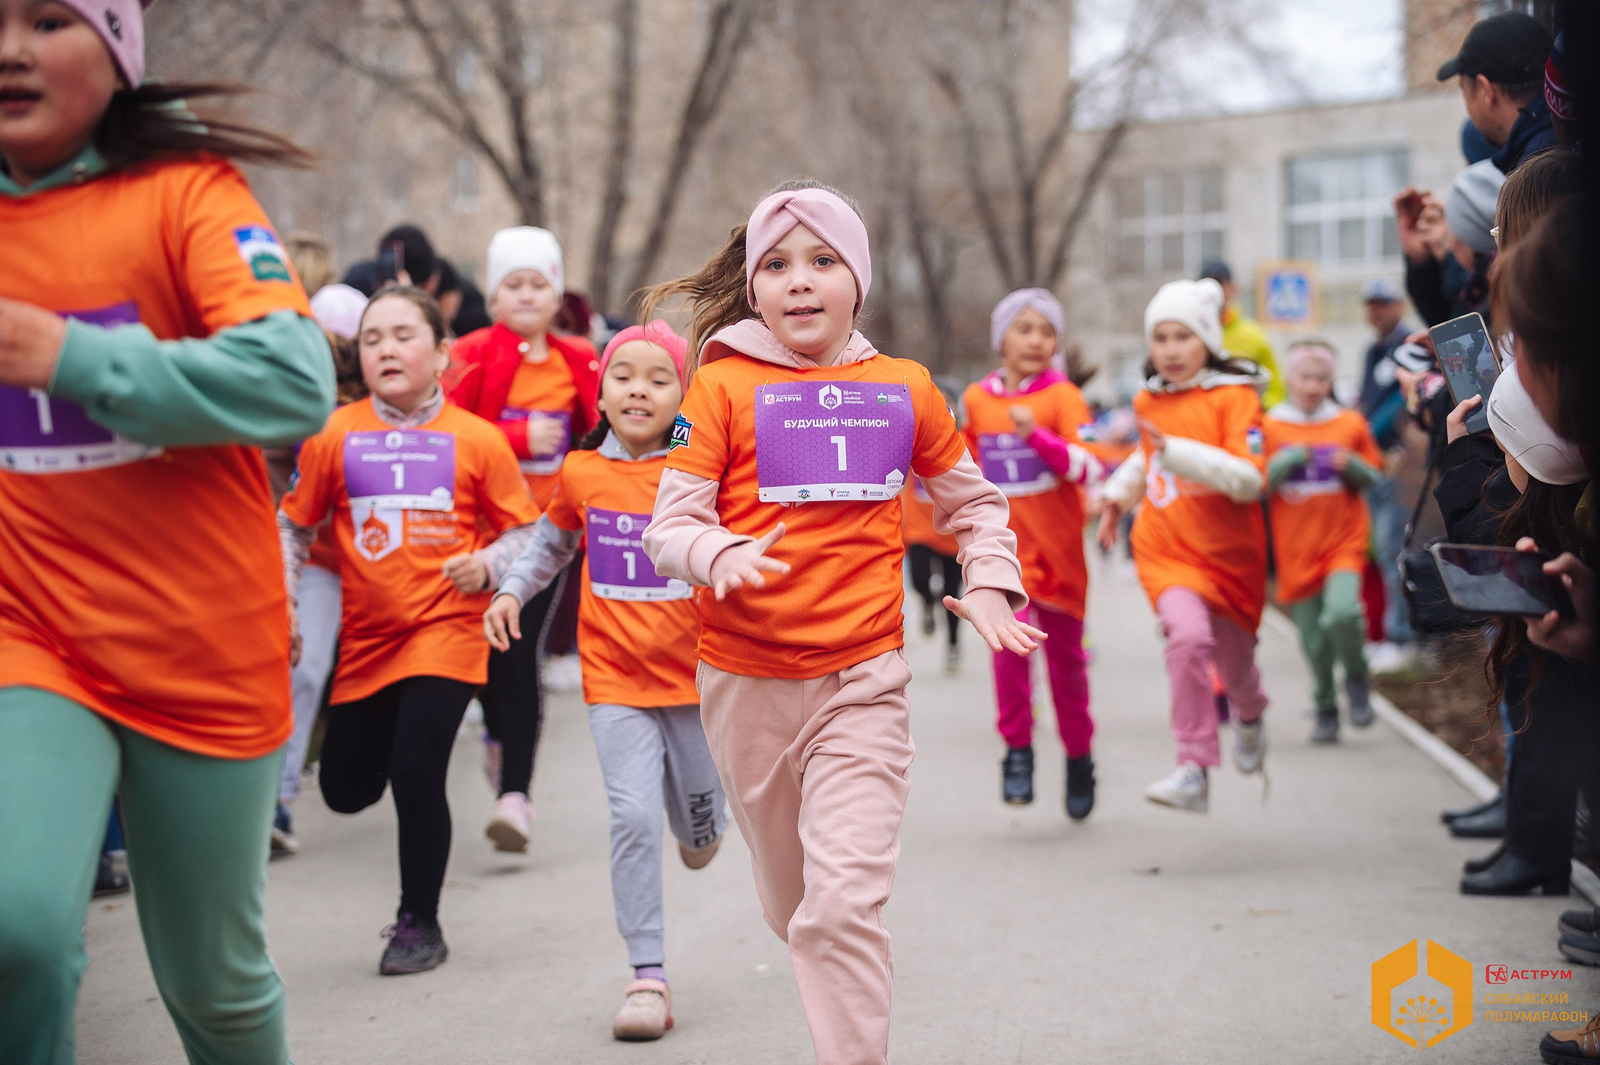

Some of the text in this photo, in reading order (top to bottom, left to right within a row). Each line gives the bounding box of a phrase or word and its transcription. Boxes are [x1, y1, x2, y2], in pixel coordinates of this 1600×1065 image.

[29, 388, 53, 434] 1
[784, 417, 889, 429] БУДУЩИЙ ЧЕМПИОН
[830, 435, 847, 471] 1
[390, 463, 405, 490] 1
[1003, 459, 1019, 481] 1
[622, 551, 636, 580] 1
